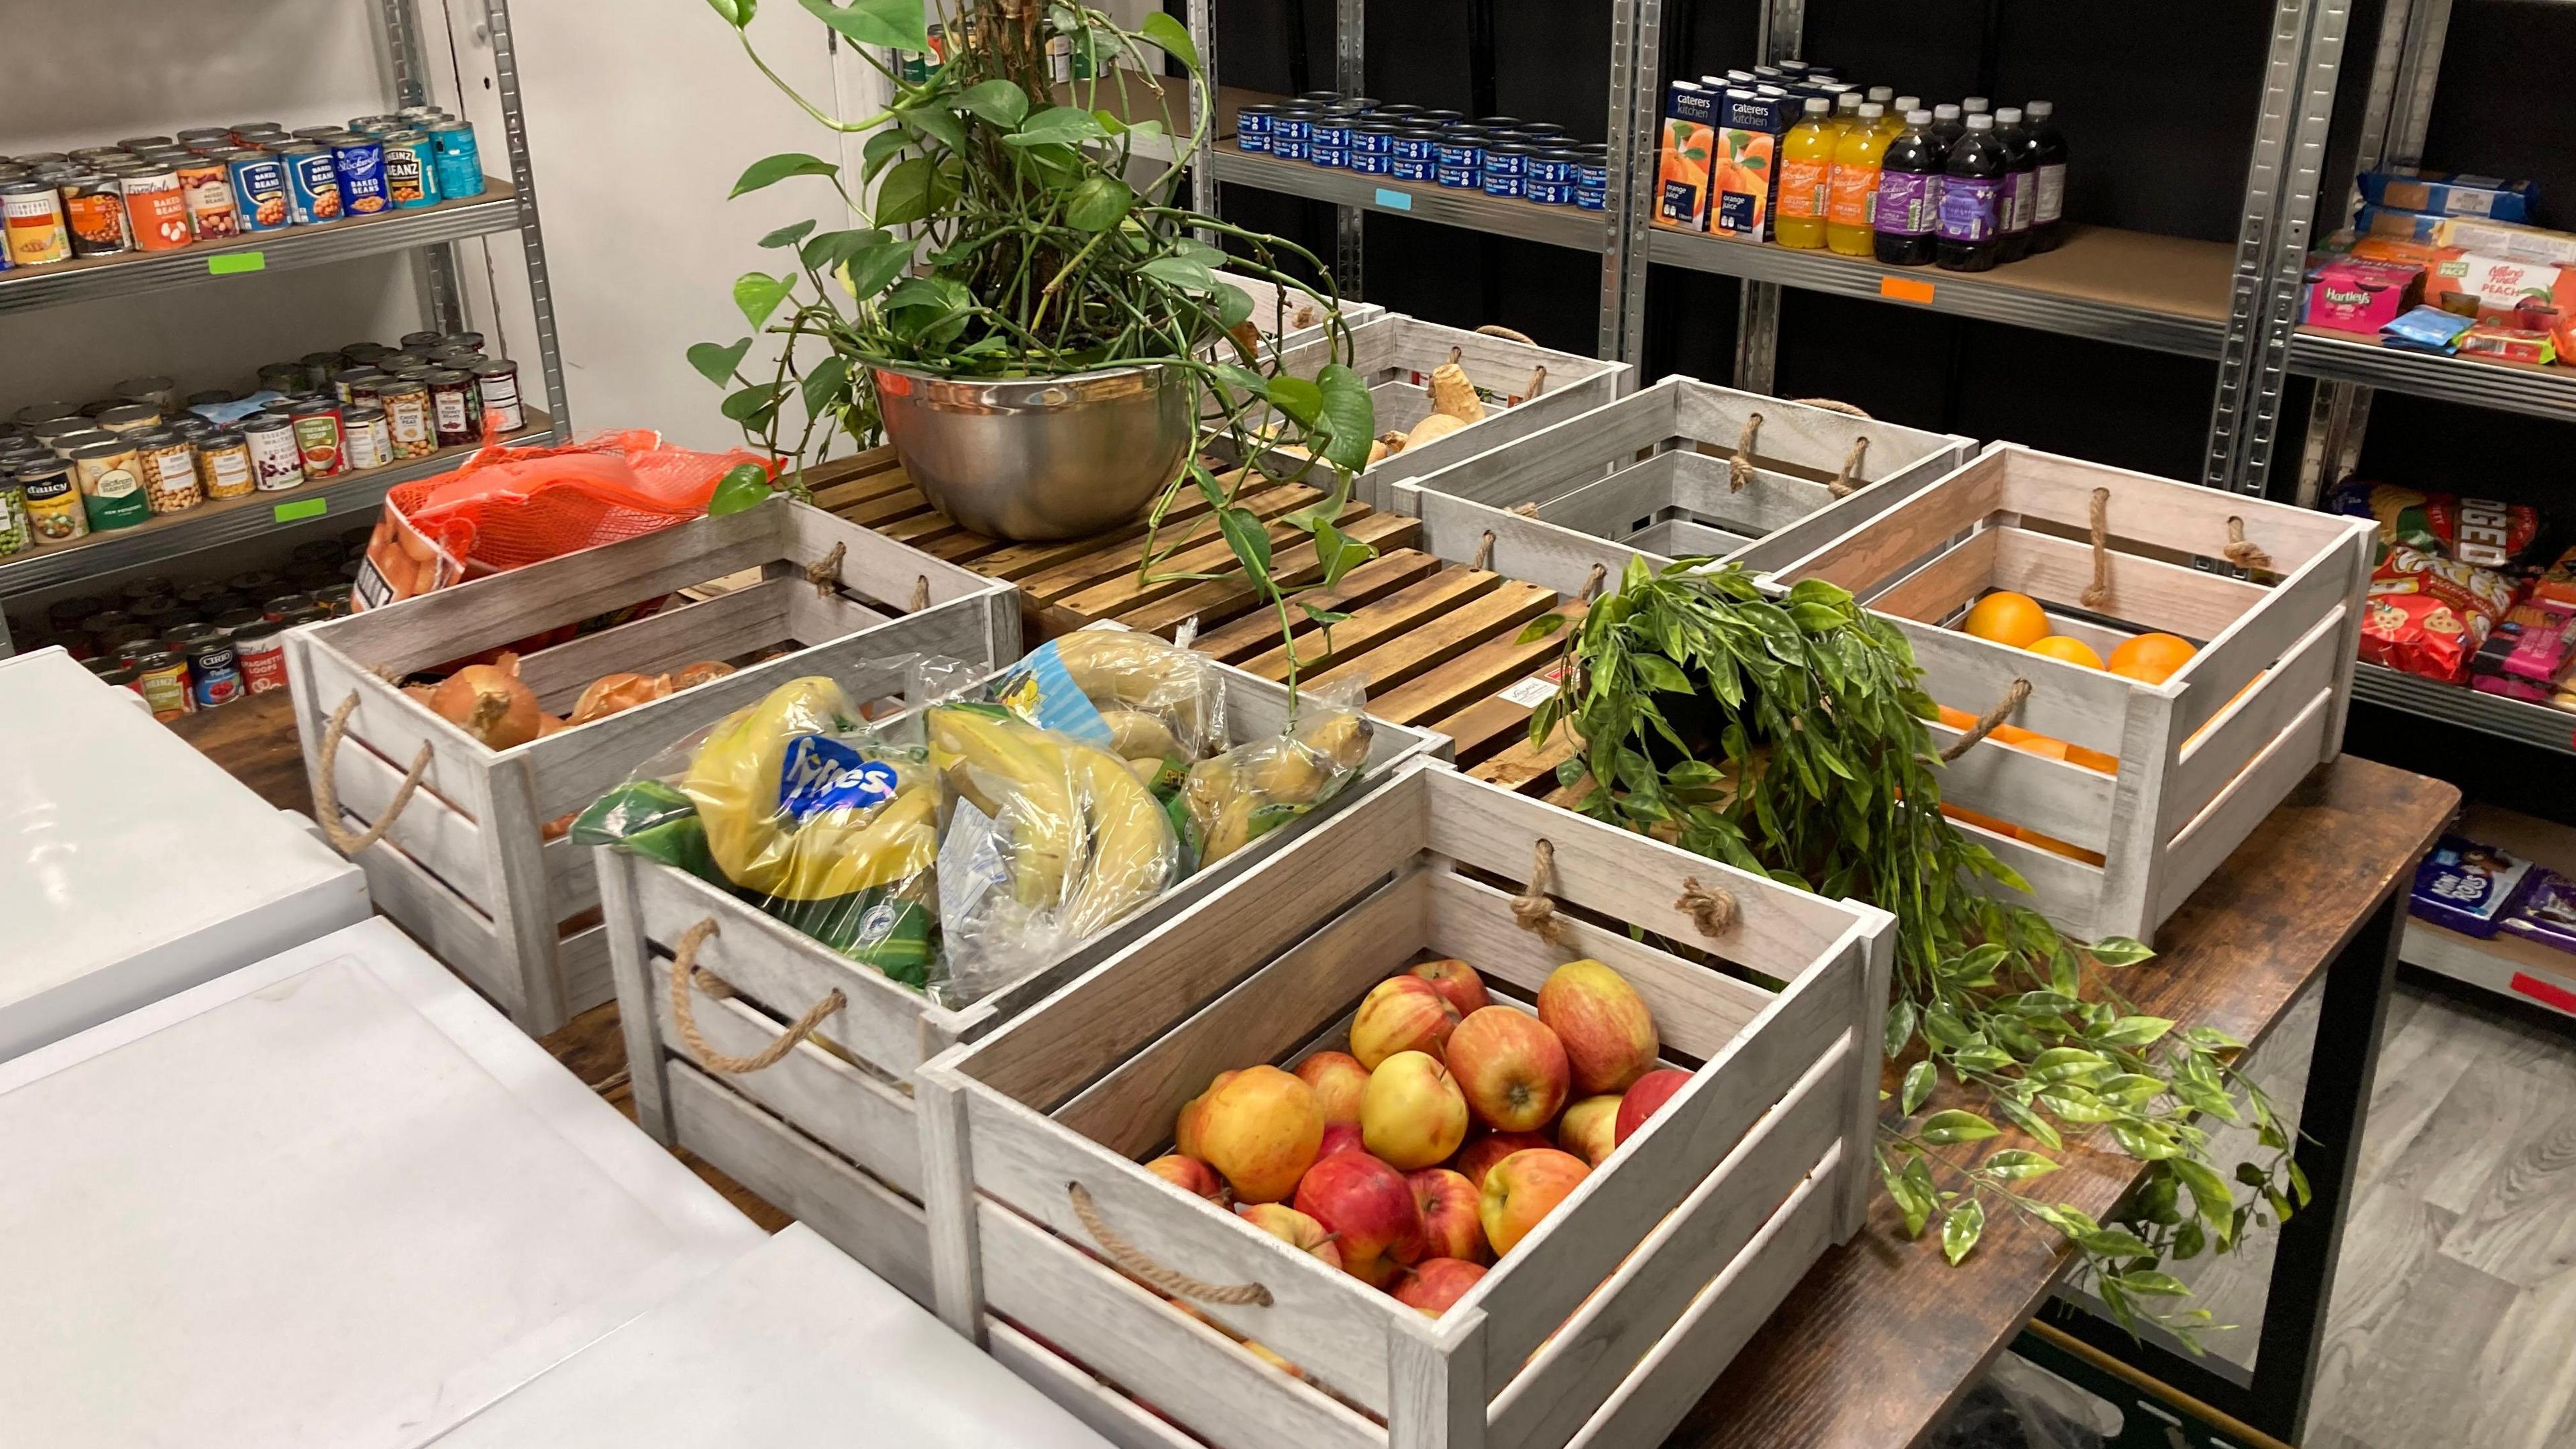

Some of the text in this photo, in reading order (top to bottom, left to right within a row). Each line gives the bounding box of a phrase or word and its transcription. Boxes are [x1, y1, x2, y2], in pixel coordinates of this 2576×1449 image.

[1677, 95, 1711, 108] caterers
[1677, 105, 1709, 119] kitchen
[1732, 103, 1768, 116] caterers
[1732, 114, 1768, 127] kitchen
[385, 152, 412, 162] HEINZ
[387, 163, 419, 176] BEANZ
[254, 172, 276, 180] BAKED
[311, 172, 334, 182] BEANS
[254, 178, 280, 189] BEANS
[350, 178, 378, 189] BAKED
[1666, 184, 1686, 194] orange
[352, 185, 380, 195] BEANS
[153, 196, 180, 208] BAKED
[1723, 195, 1745, 205] orange
[155, 205, 182, 215] BEANS
[1722, 202, 1737, 210] juice
[1835, 205, 1862, 214] ORANGE
[2326, 287, 2372, 305] Hartley's
[2481, 284, 2520, 297] PEACH
[203, 652, 230, 665] CIRIO
